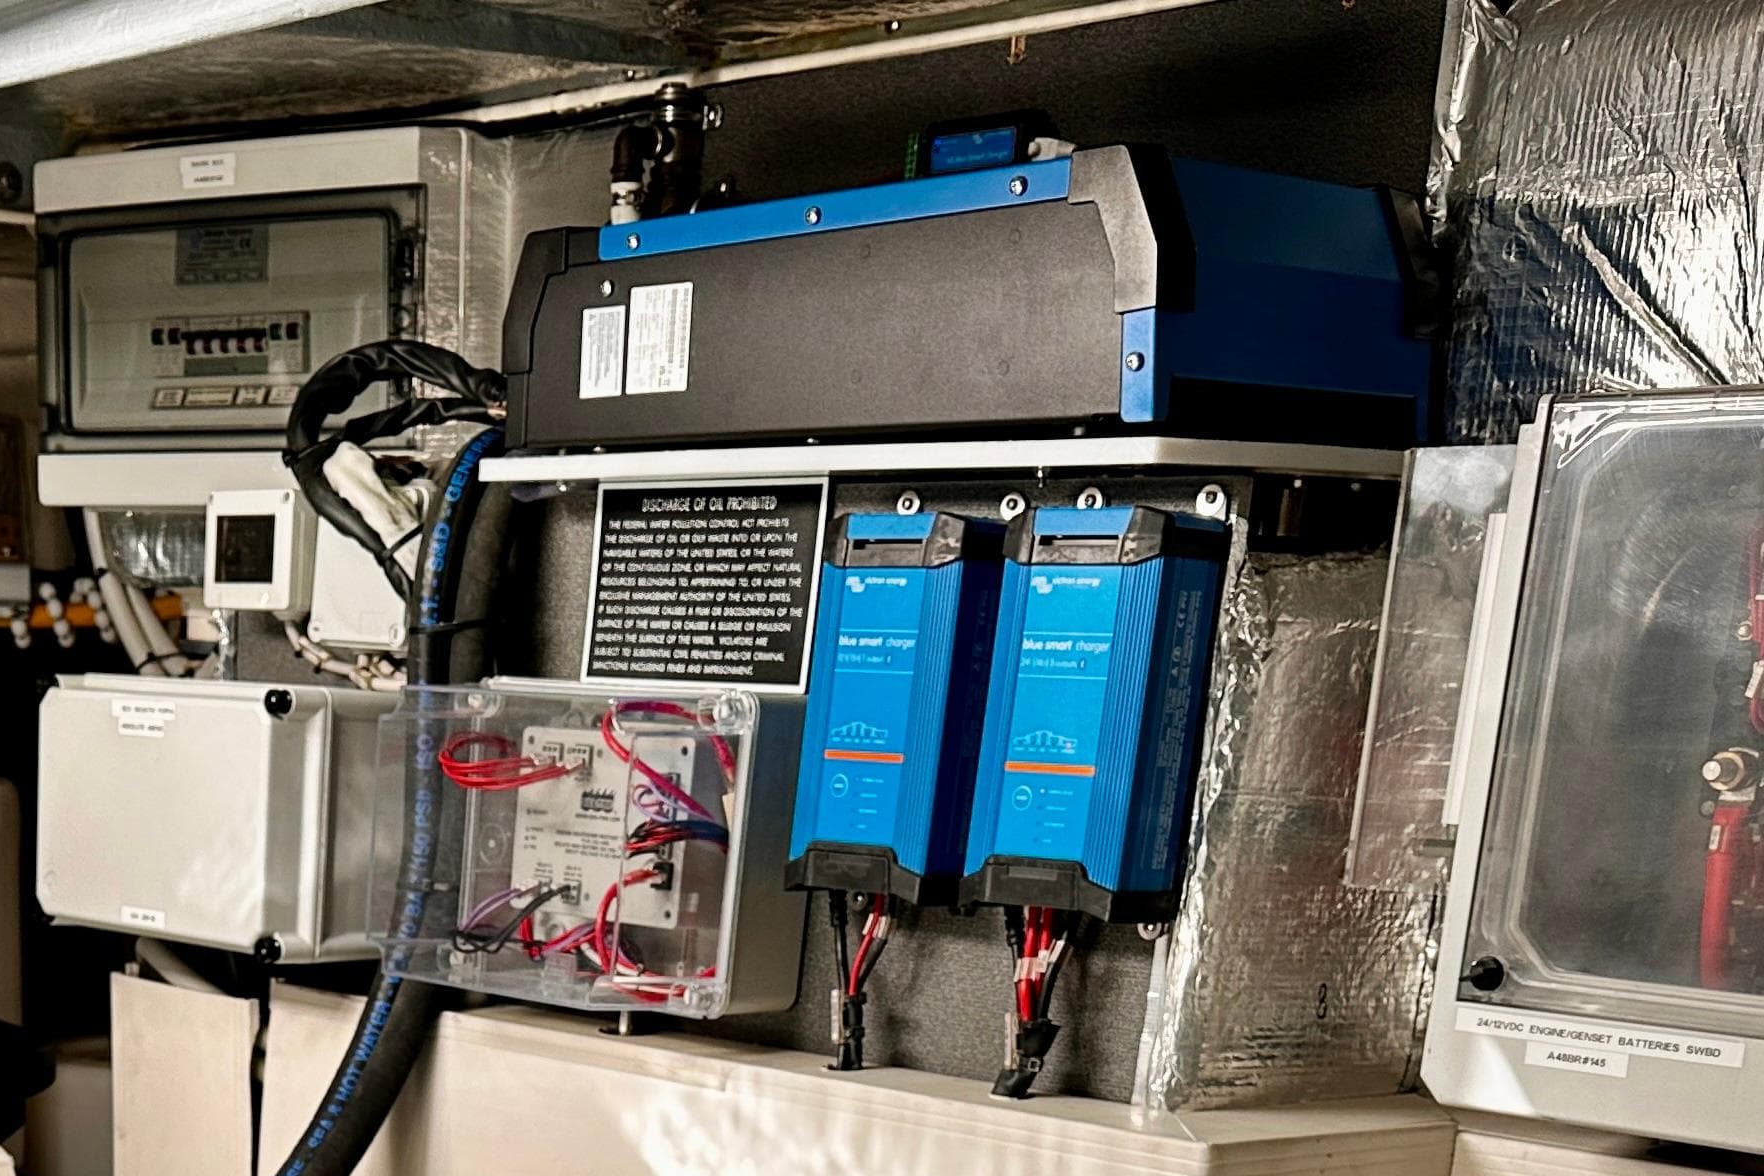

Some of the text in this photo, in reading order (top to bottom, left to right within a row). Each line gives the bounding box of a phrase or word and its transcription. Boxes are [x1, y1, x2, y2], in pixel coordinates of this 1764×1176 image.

[425, 520, 452, 573] S&D
[1045, 640, 1073, 651] smart
[333, 1064, 364, 1103] HOT
[352, 998, 393, 1064] WATER
[1477, 1016, 1524, 1033] 24/12VDC
[1529, 1025, 1612, 1045] ENGINE/GENSET
[1618, 1036, 1680, 1053] BATTERIES
